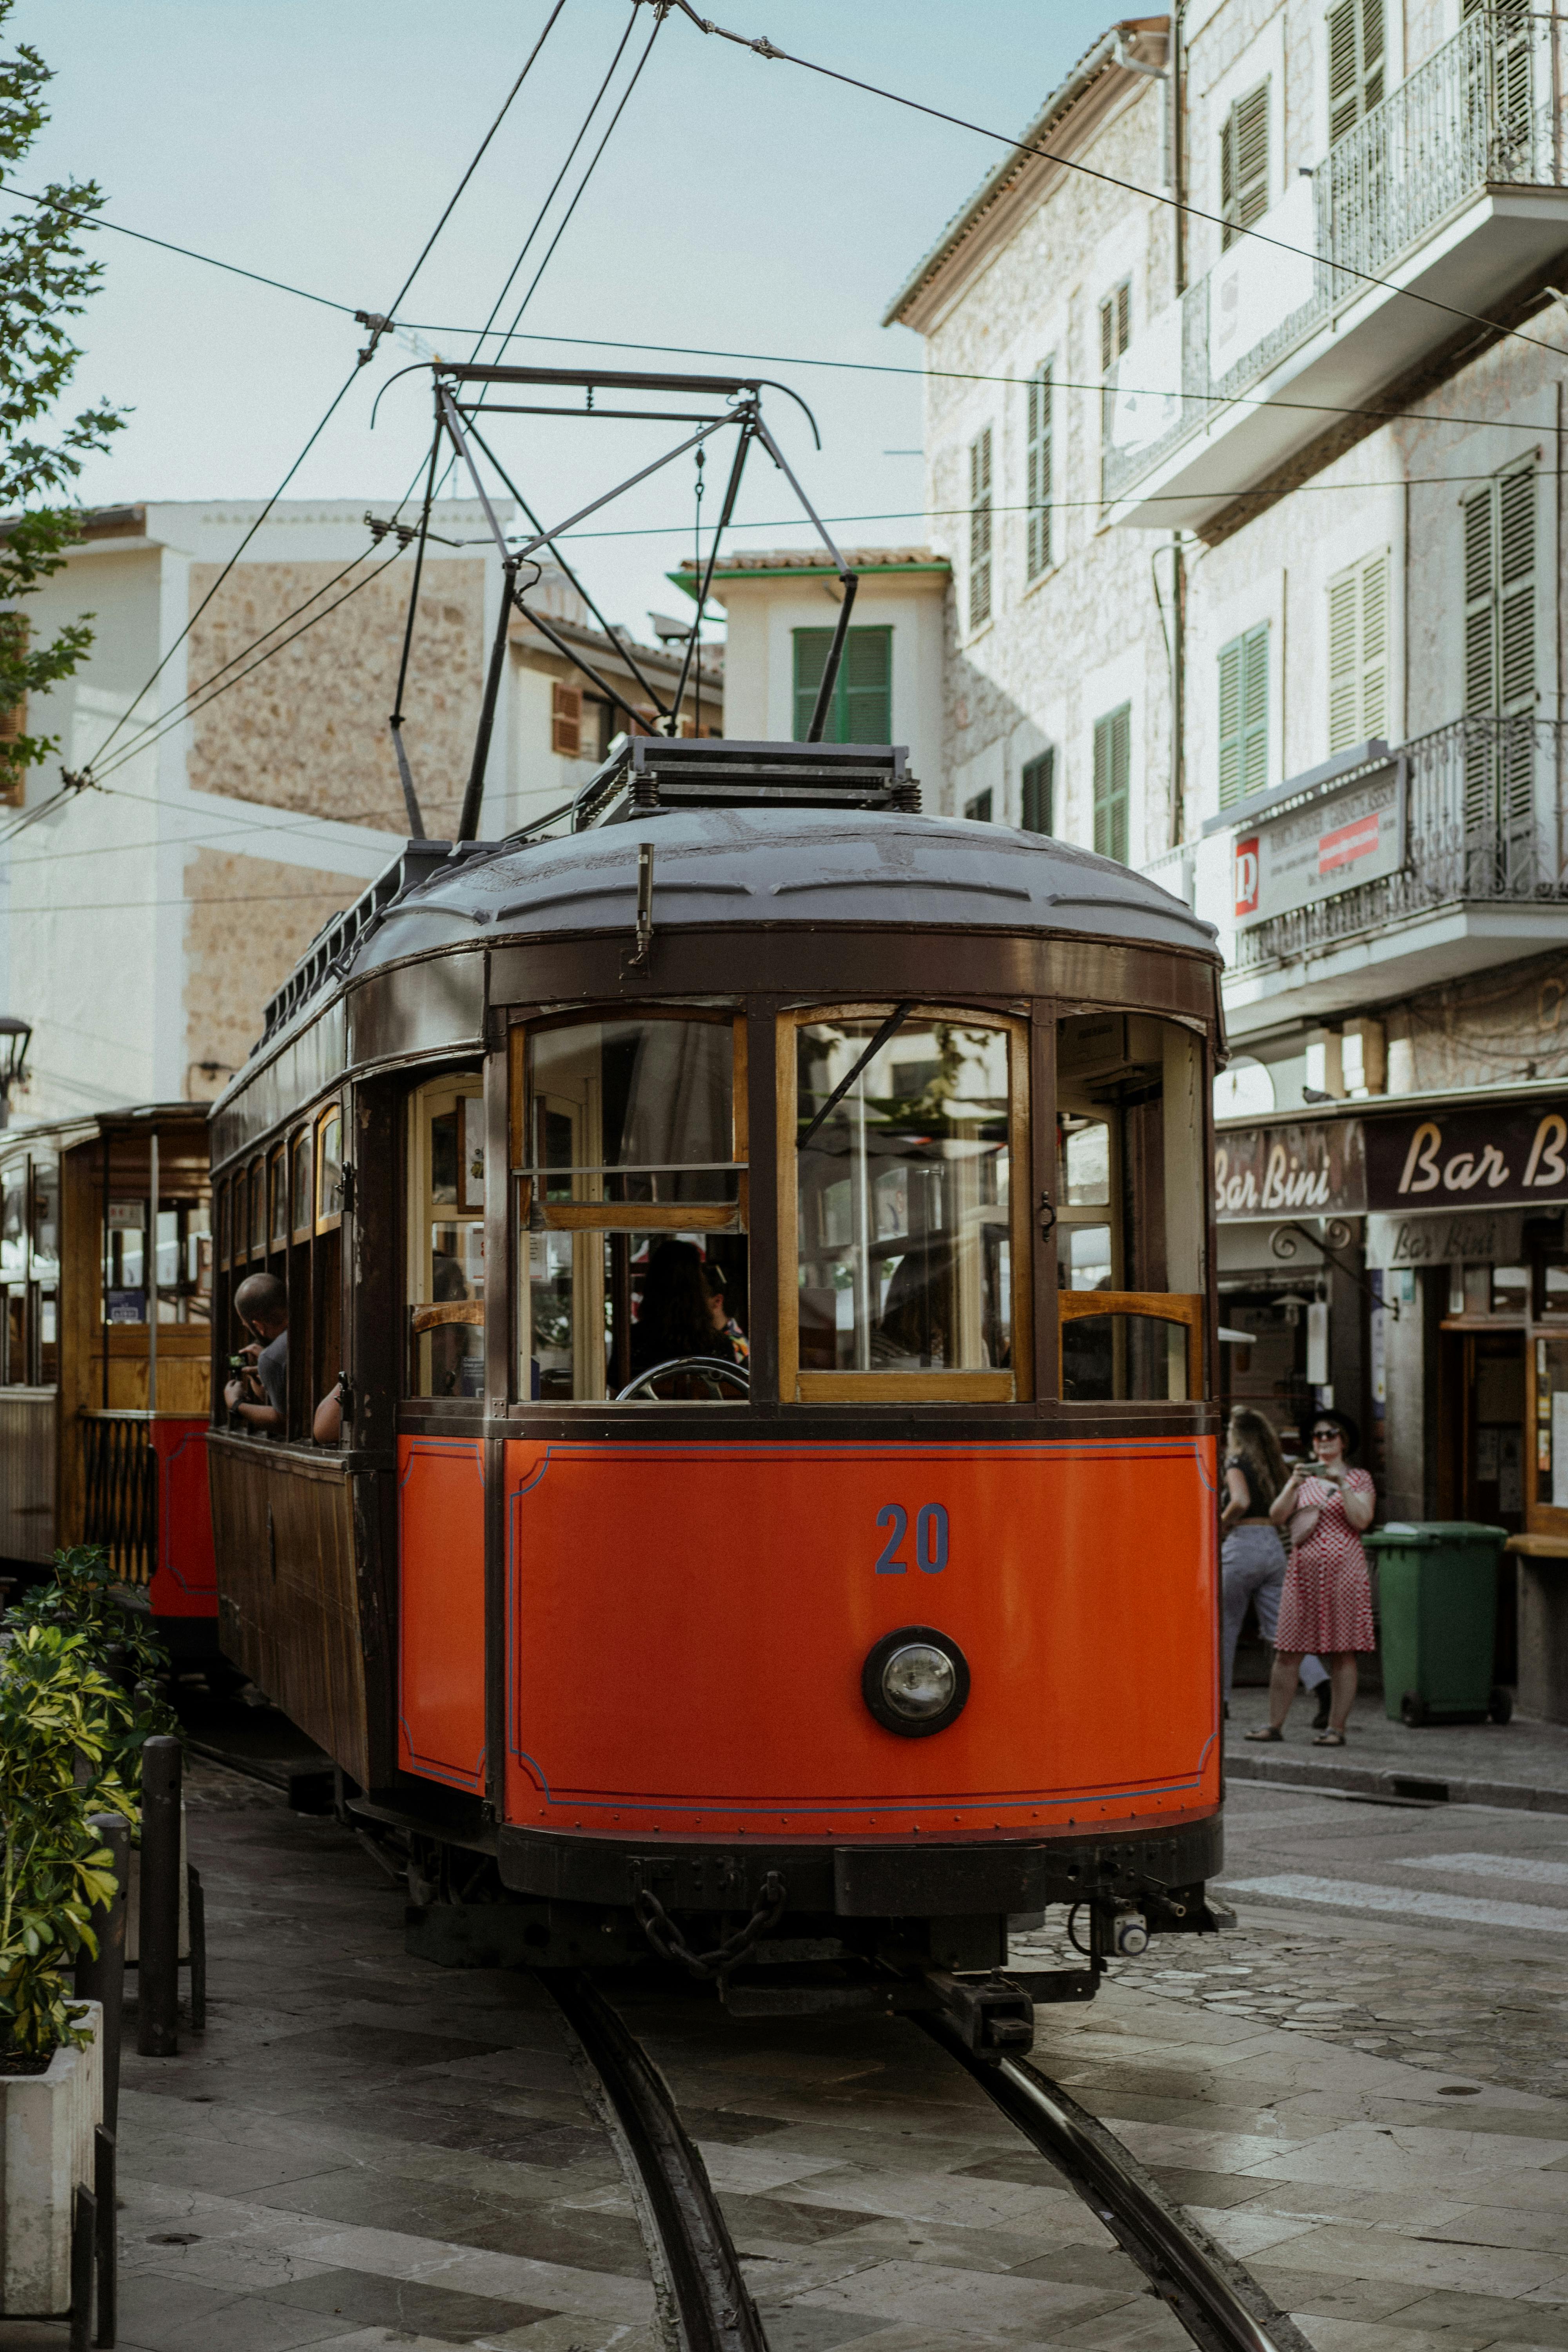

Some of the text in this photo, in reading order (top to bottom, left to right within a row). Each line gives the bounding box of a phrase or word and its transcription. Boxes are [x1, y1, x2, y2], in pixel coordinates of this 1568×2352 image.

[1215, 1144, 1330, 1210] Bar Bini
[1398, 1114, 1568, 1194] Bar B
[1392, 1222, 1431, 1260] Bar
[875, 1503, 949, 1574] 20
